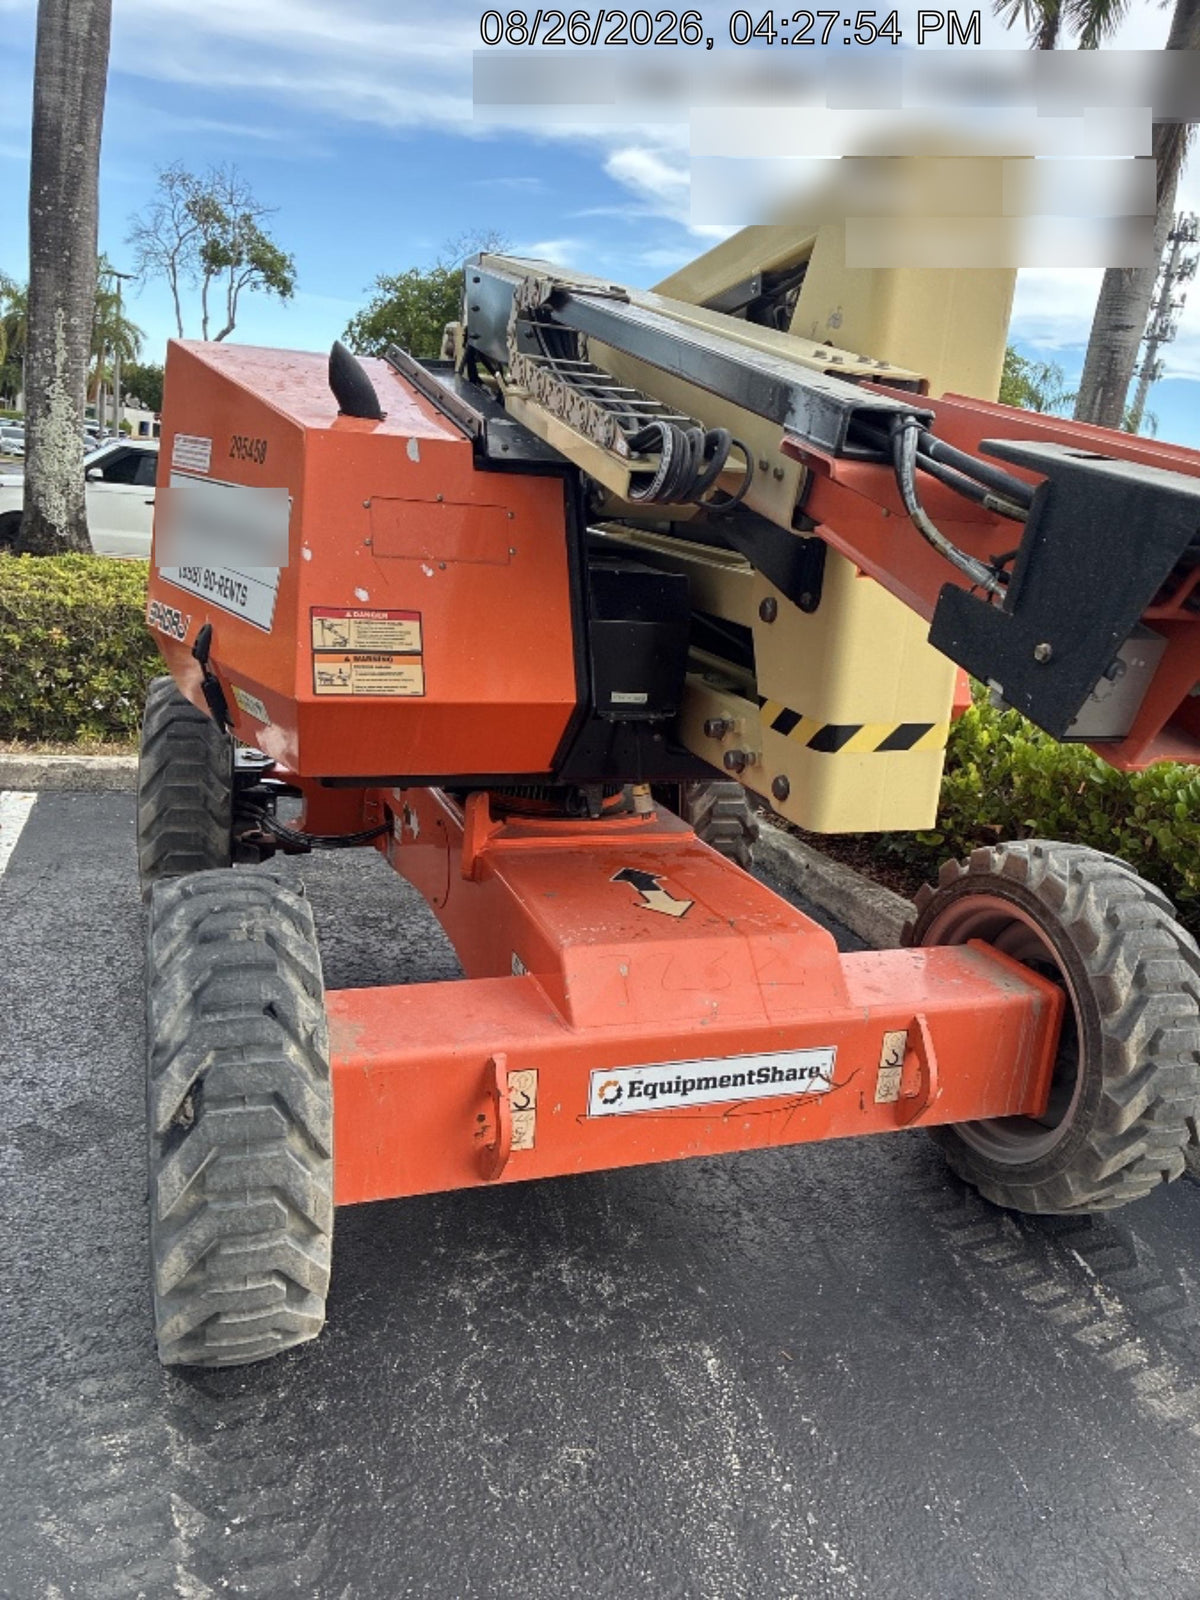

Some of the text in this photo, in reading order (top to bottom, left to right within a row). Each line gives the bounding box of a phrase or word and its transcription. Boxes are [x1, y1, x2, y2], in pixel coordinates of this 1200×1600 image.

[203, 568, 248, 607] 90-RENTS
[353, 611, 388, 620] DANGER
[353, 655, 393, 663] WARNING
[627, 1065, 821, 1101] EquipmentShare
